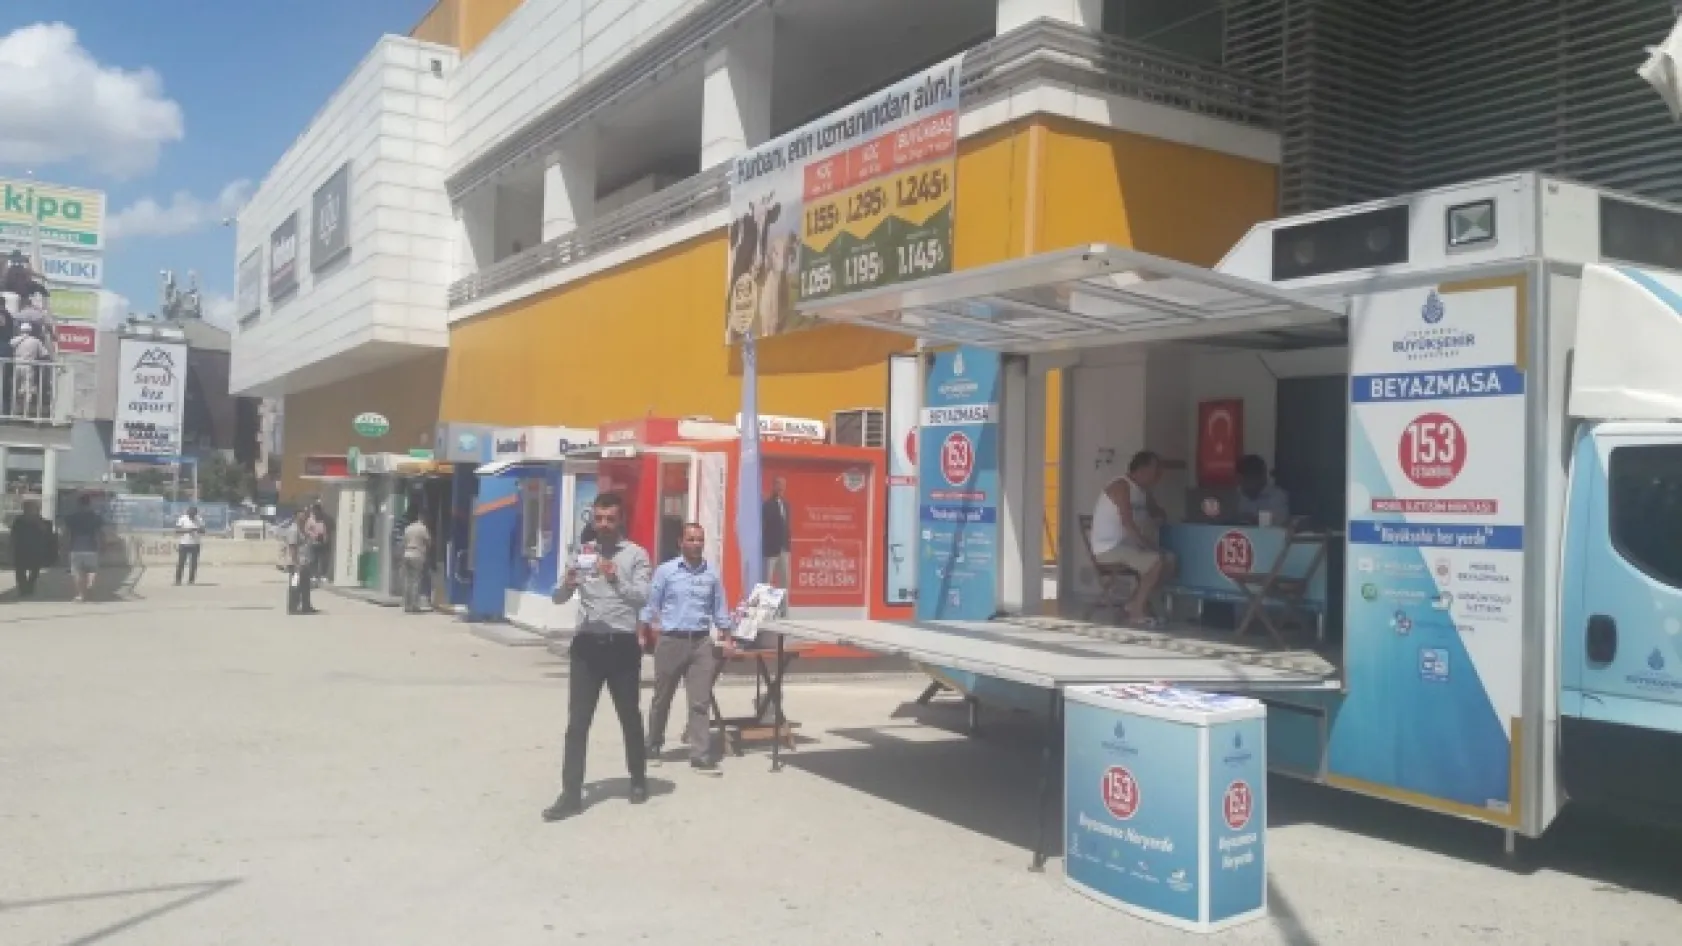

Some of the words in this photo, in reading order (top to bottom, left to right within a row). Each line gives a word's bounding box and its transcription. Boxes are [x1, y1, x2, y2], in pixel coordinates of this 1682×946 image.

[5, 183, 82, 222] kipa
[1371, 370, 1502, 399] BEYAZMASA
[929, 407, 989, 424] BEYAZMASA
[1408, 422, 1457, 464] 153
[1108, 771, 1131, 802] 153
